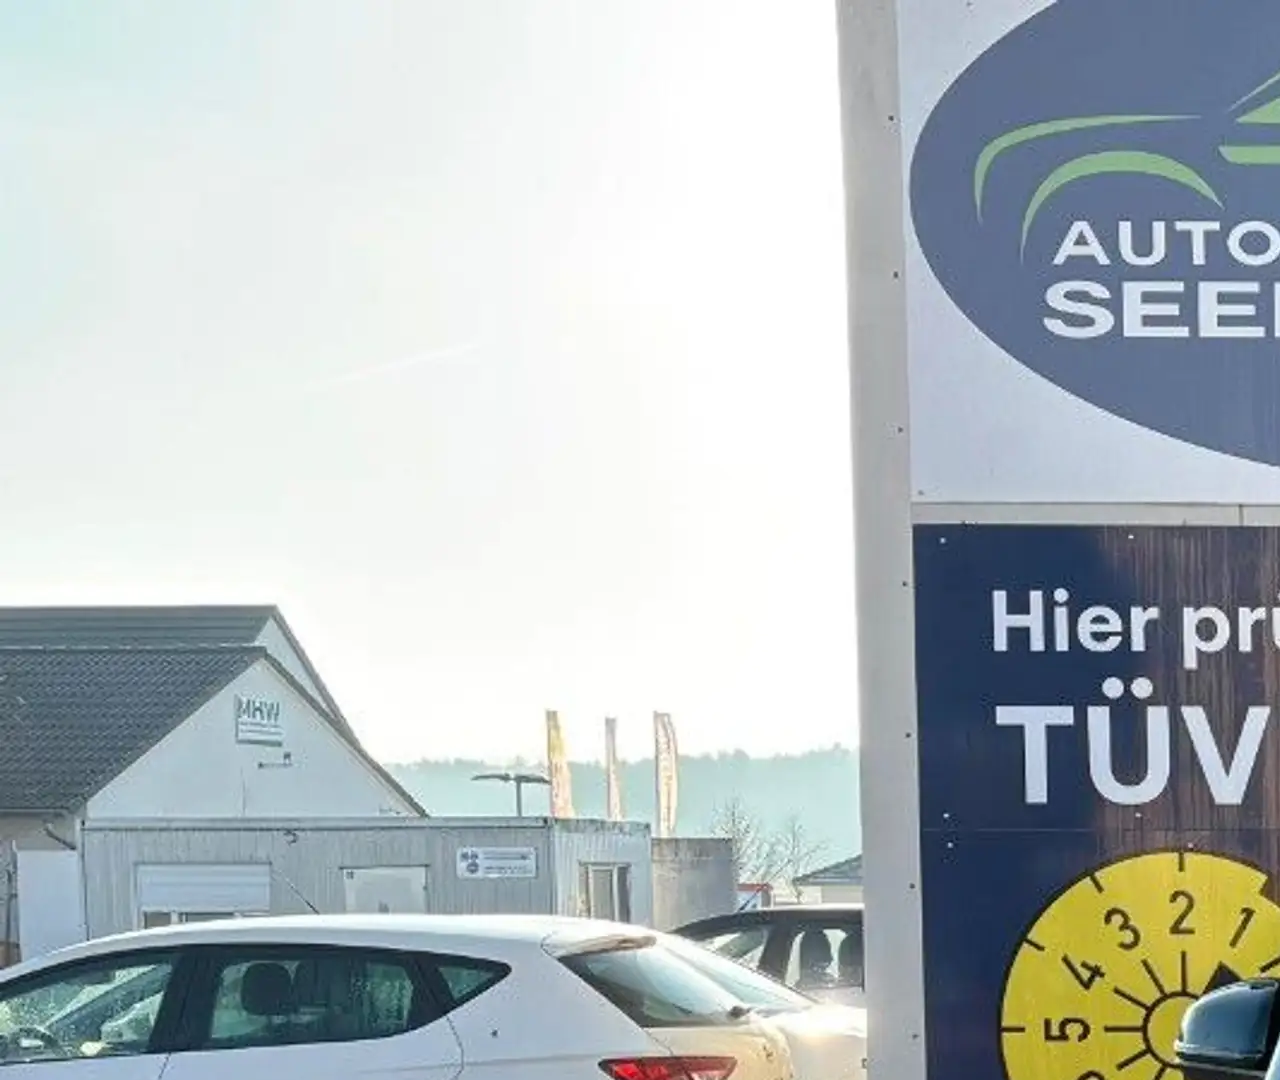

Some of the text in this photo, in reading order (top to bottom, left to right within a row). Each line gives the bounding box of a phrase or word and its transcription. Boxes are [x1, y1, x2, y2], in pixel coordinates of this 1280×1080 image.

[992, 587, 1160, 653] Hier
[995, 676, 1272, 806] TÜV
[1102, 906, 1141, 951] 3
[1168, 889, 1196, 936] 2
[1228, 906, 1257, 949] 1
[1060, 953, 1107, 991] 4
[1043, 1016, 1092, 1043] 5
